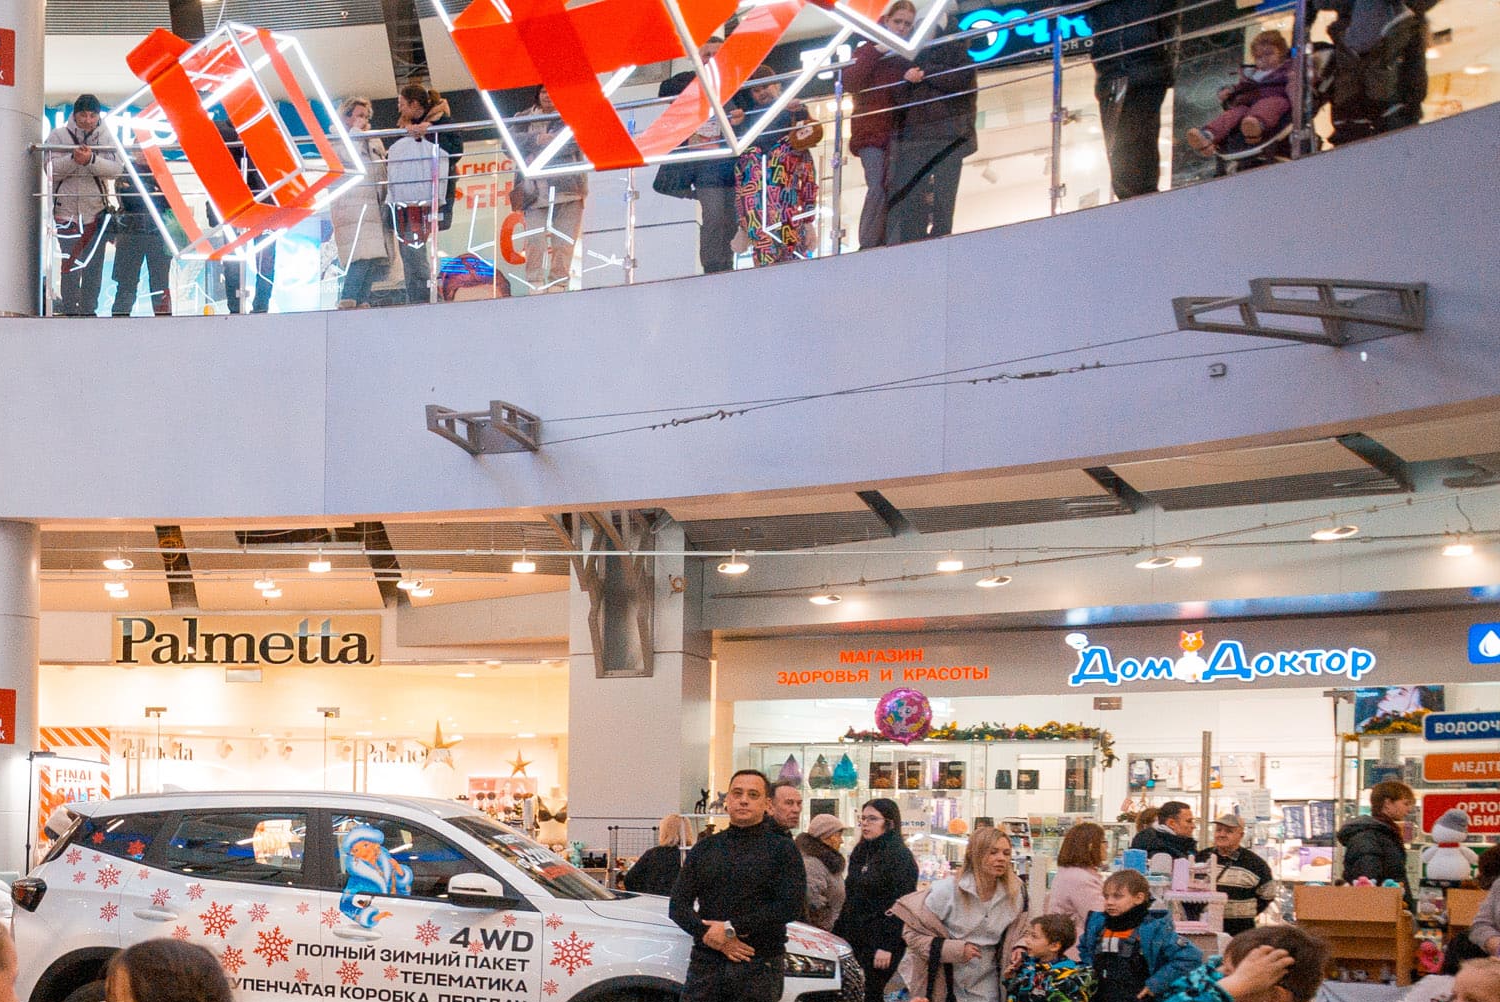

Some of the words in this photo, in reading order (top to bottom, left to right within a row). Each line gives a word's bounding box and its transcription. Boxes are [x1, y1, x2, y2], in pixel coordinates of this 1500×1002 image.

[116, 617, 375, 665] Palmetta
[838, 648, 924, 664] МАГАЗИН
[1070, 647, 1174, 686] Дом
[1201, 640, 1377, 680] Доктор
[777, 669, 869, 686] ЗДОРОВЬЯ
[880, 669, 893, 682] И
[903, 666, 989, 681] КРАСОТЫ
[56, 787, 96, 802] SALE
[296, 943, 376, 961] ПОЛНЫЙ
[380, 949, 460, 967] ЗИМНИЙ
[465, 955, 530, 972] ПАКЕТ
[228, 977, 336, 998] УПЕНЧАТАЯ
[400, 970, 528, 993] ТЕЛЕМАТИКА
